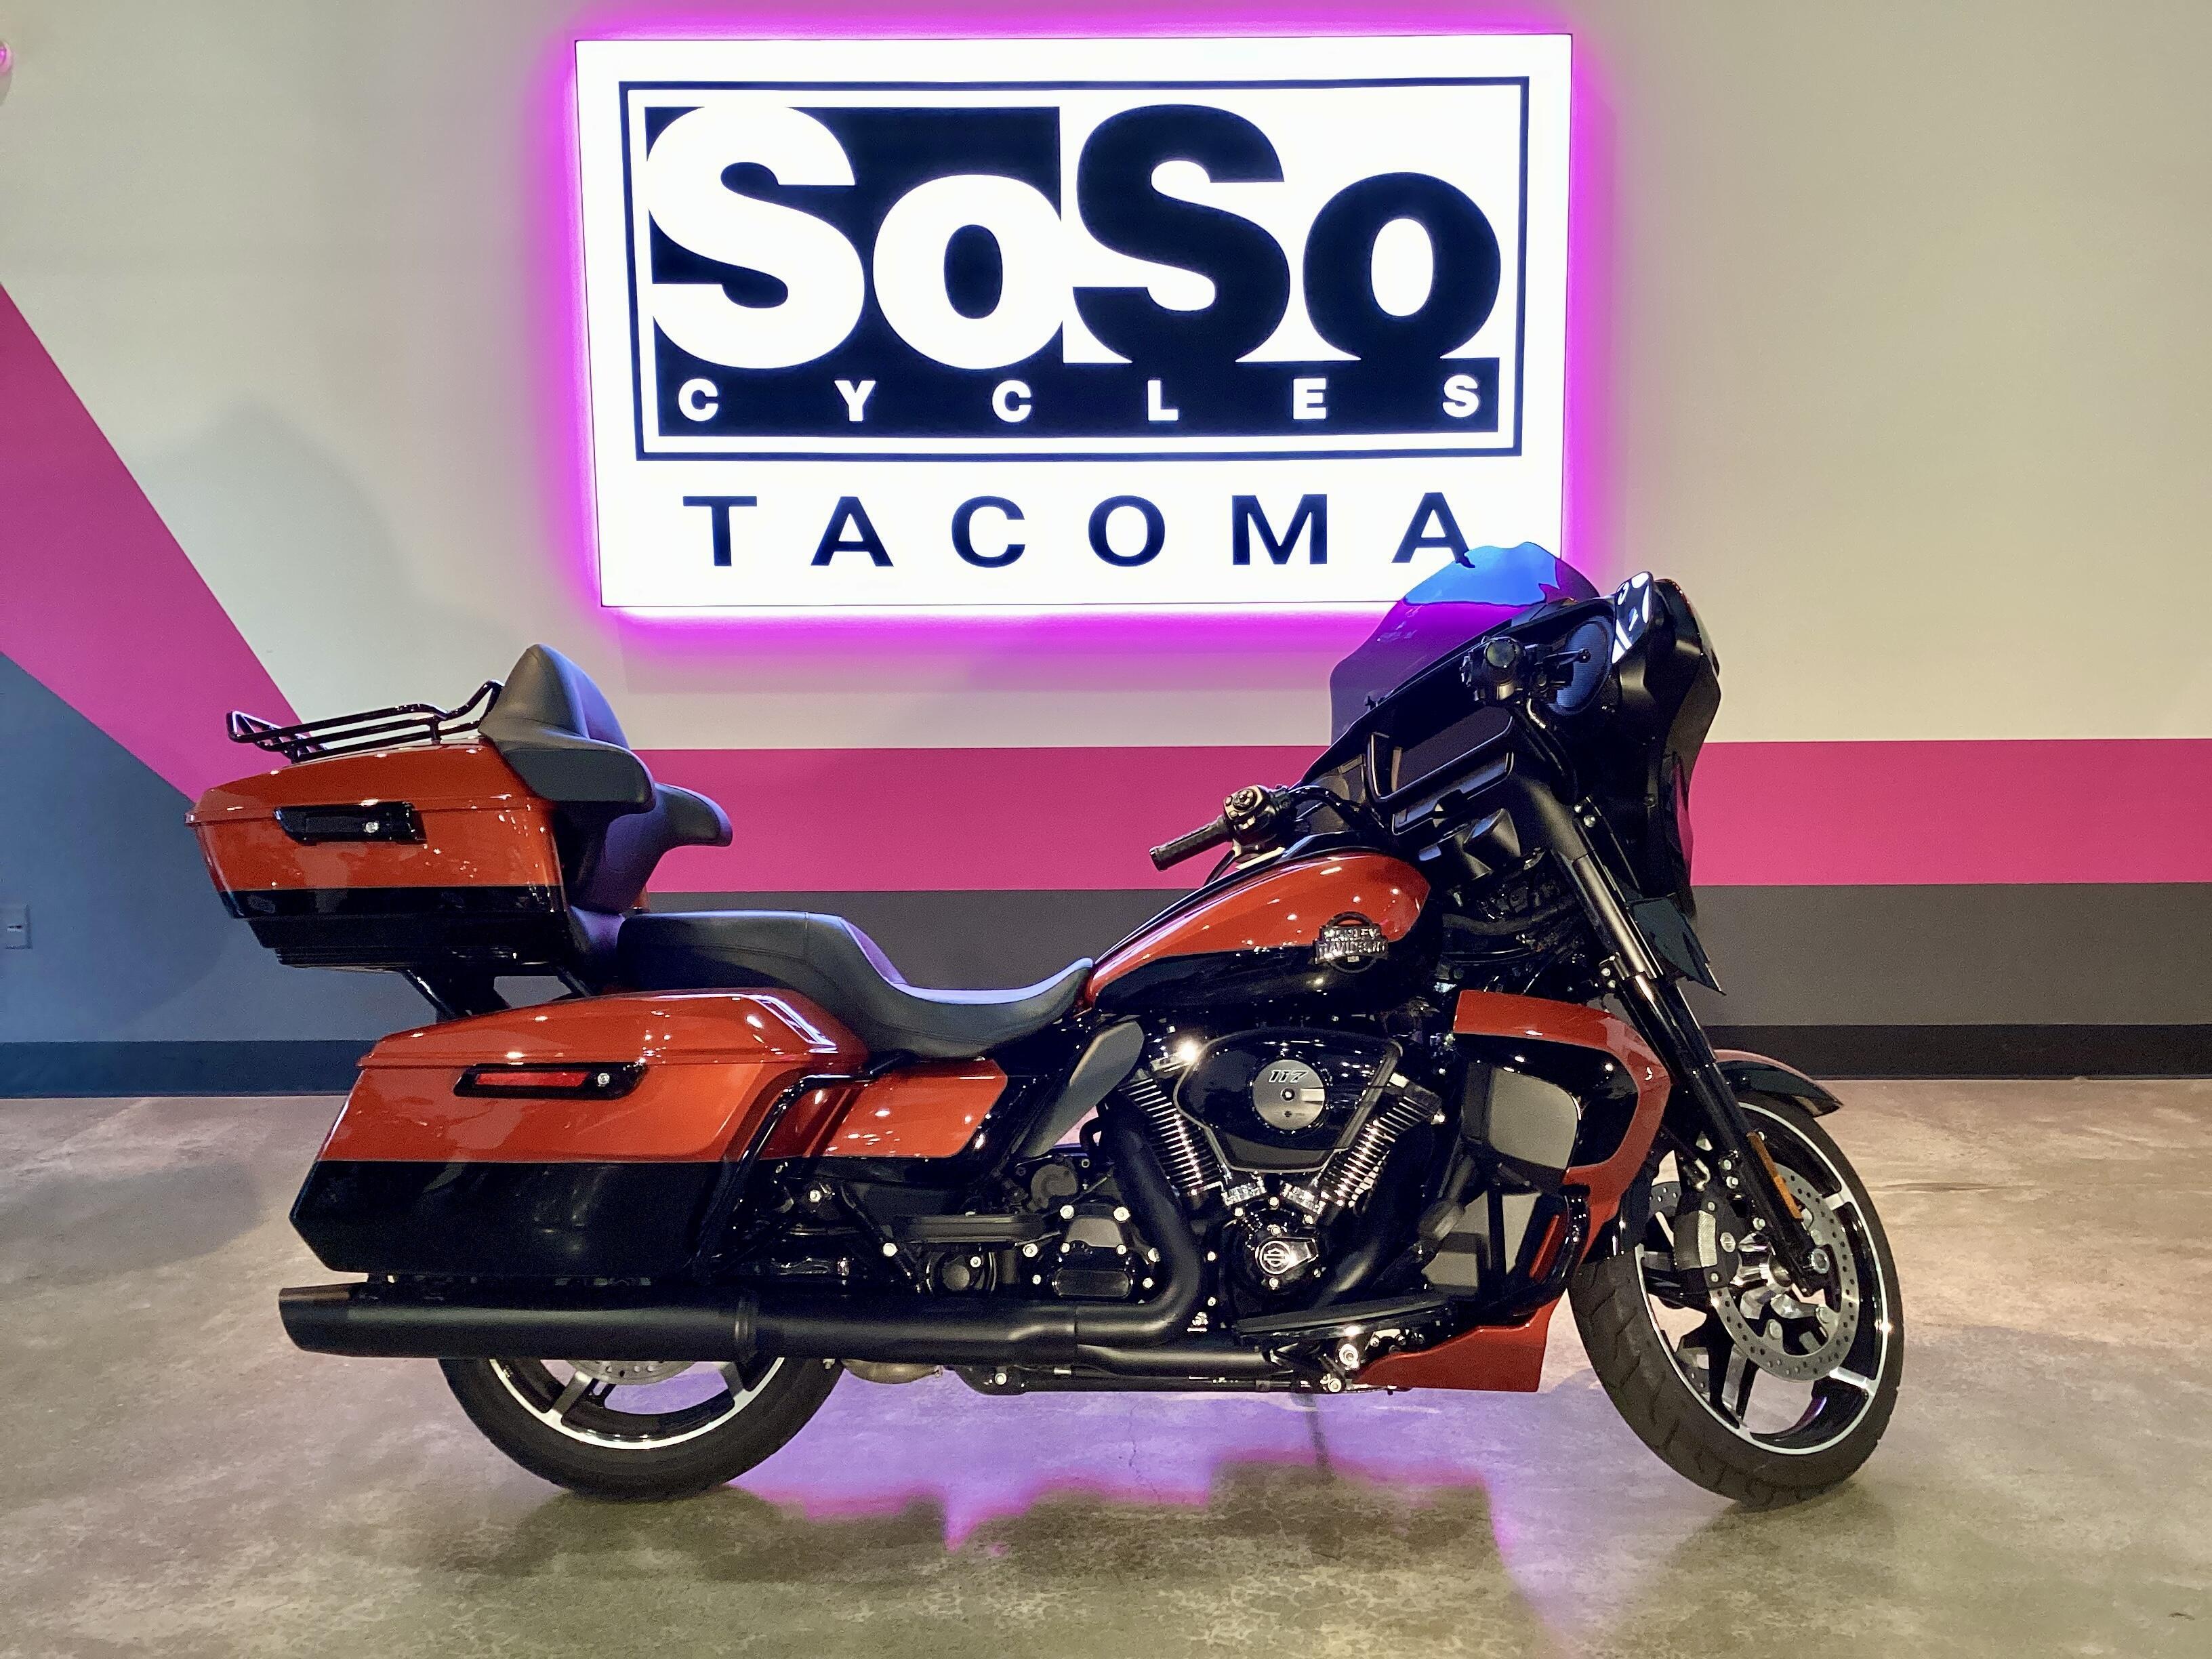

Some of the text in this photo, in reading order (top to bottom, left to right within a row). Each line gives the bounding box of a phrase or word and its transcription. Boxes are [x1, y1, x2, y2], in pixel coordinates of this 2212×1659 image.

[647, 104, 1500, 371] SoSo
[678, 375, 1479, 422] CYCLES
[683, 493, 1474, 568] TACOMA
[1268, 1069, 1309, 1083] 117
